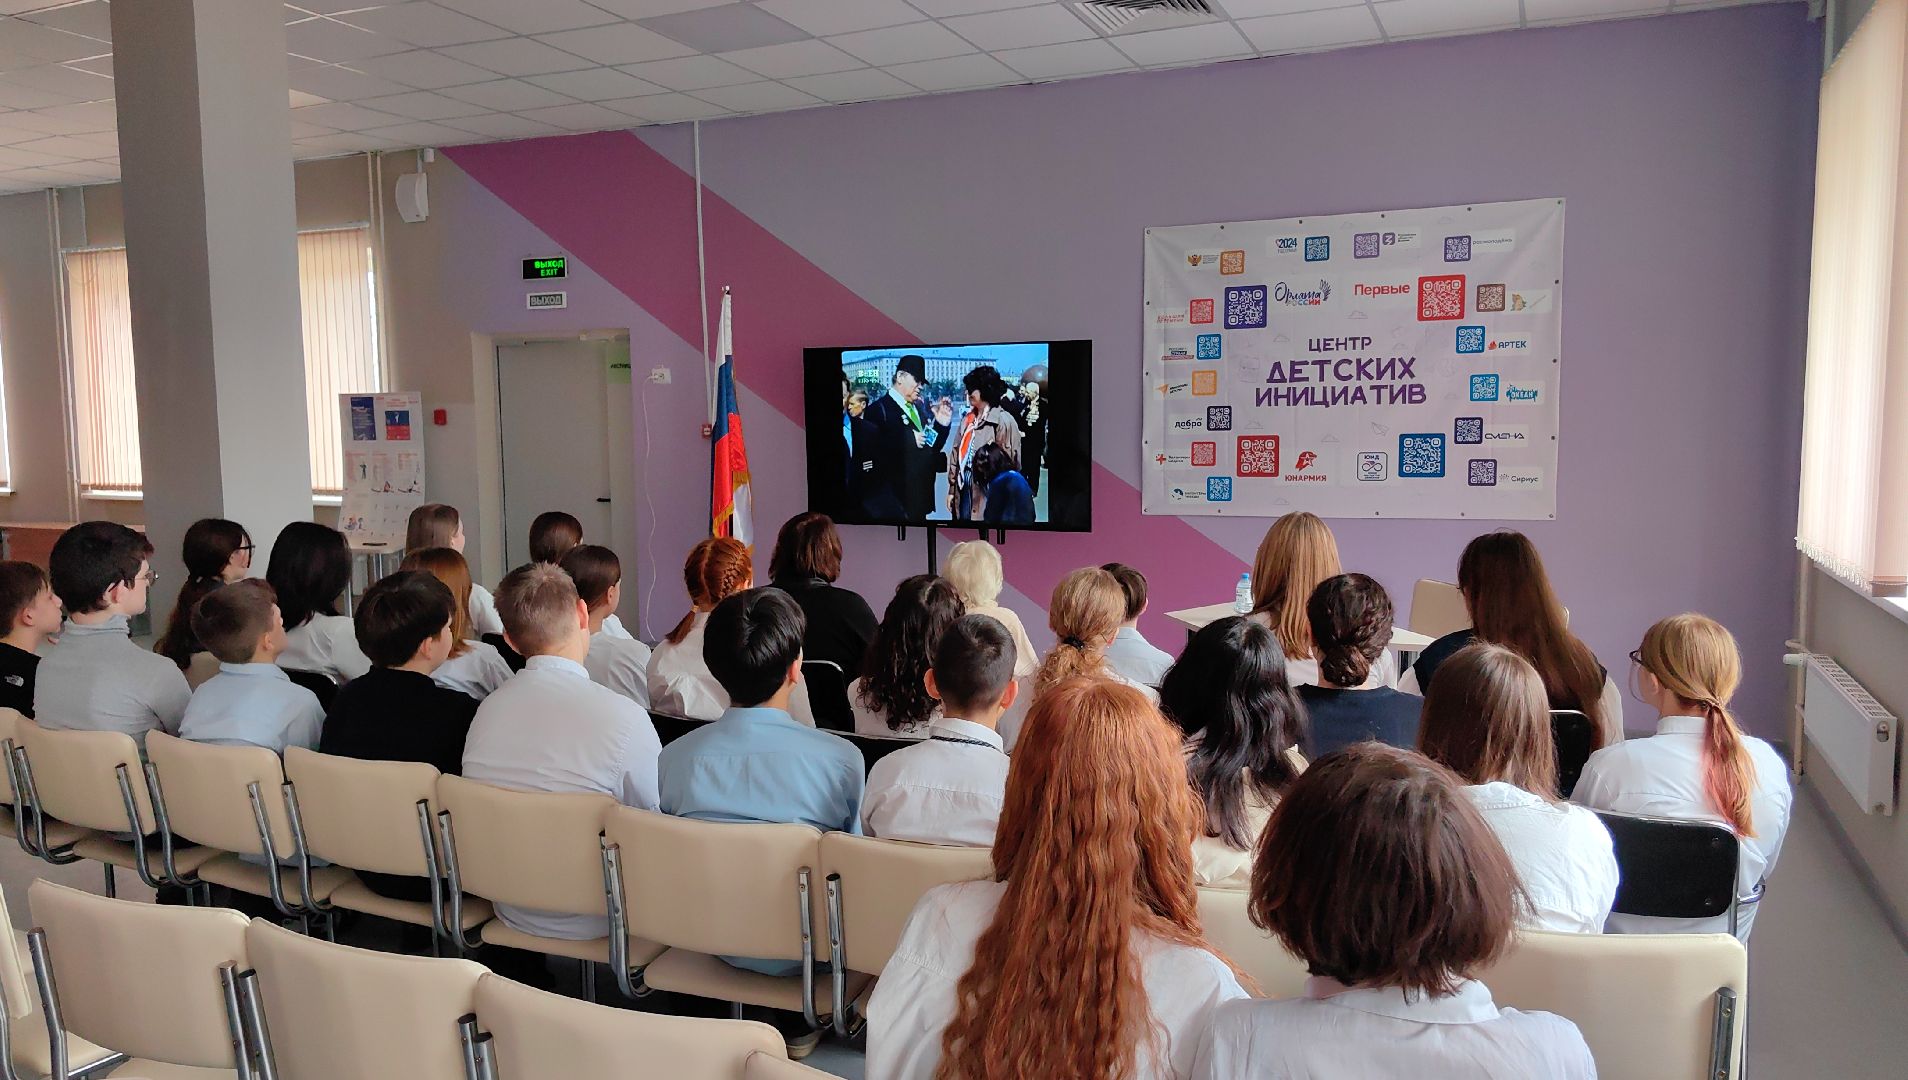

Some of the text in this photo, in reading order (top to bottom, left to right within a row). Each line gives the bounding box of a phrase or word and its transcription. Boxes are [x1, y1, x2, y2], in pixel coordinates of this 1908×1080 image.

[534, 259, 564, 269] ВЫХОД
[540, 268, 558, 276] EXIT
[1354, 283, 1410, 298] Первые
[530, 295, 562, 306] ВЫХОД
[1308, 336, 1372, 352] ЦЕНТР
[1498, 340, 1527, 349] АРТЕК
[1266, 357, 1416, 384] ДЕТСКИХ
[1255, 384, 1427, 408] ИНИЦИАТИВ
[1284, 474, 1327, 482] ЮНАРМИЯ
[1511, 475, 1539, 484] Сириус
